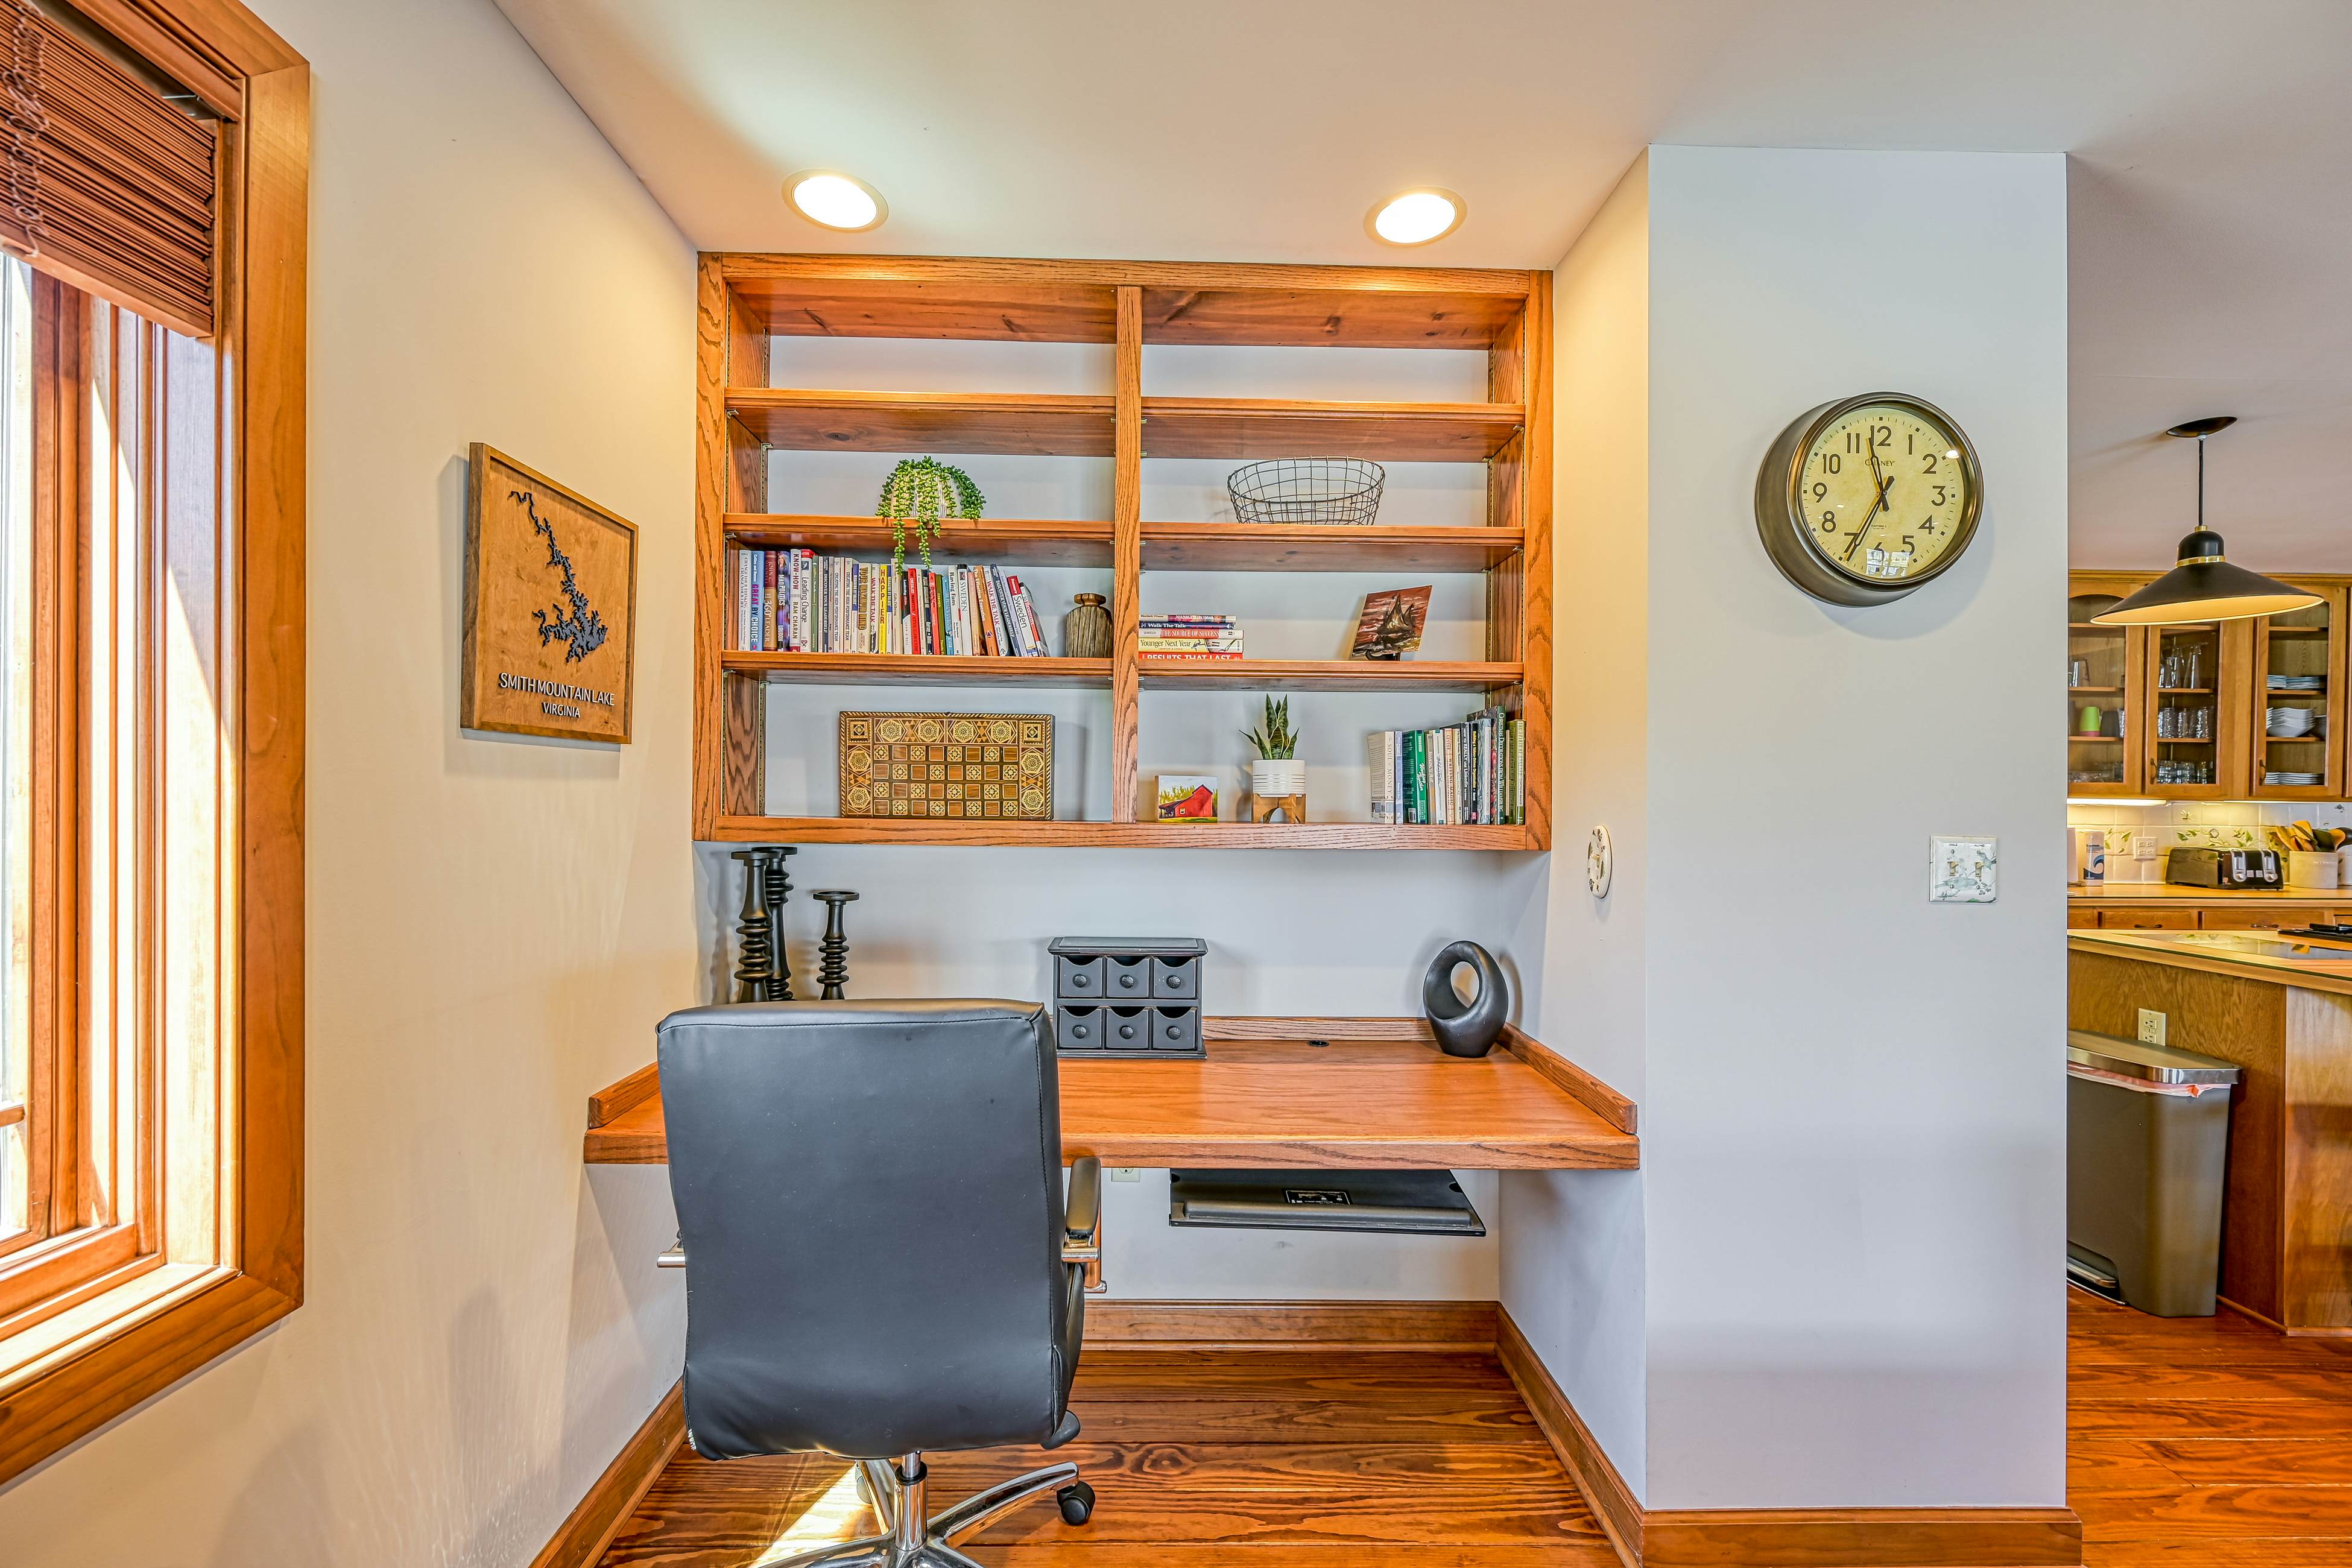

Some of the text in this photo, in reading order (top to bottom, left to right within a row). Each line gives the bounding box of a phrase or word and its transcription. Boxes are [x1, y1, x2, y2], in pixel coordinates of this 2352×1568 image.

[1847, 433, 1860, 454] 11
[1870, 425, 1892, 447] 12
[1908, 434, 1913, 455] 1
[1822, 454, 1841, 475] 10
[1922, 454, 1937, 475] 2
[1812, 482, 1827, 503] 9
[1931, 485, 1946, 507] 3
[1821, 510, 1836, 533] 8
[1918, 515, 1935, 534] 4
[1844, 533, 1859, 553] 7
[1871, 542, 1885, 564] 6
[1901, 536, 1915, 556] 5
[859, 567, 868, 584] YOUR
[800, 577, 809, 623] Leading Change
[858, 584, 868, 613] MAXIMUM
[959, 582, 968, 612] SWEDEN
[858, 613, 868, 631] MIND
[1014, 596, 1027, 628] Sweden
[1140, 639, 1164, 648] Younger
[499, 672, 615, 706] SMITH MOUNTAIN LAKE
[542, 701, 581, 718] VIRGINIA
